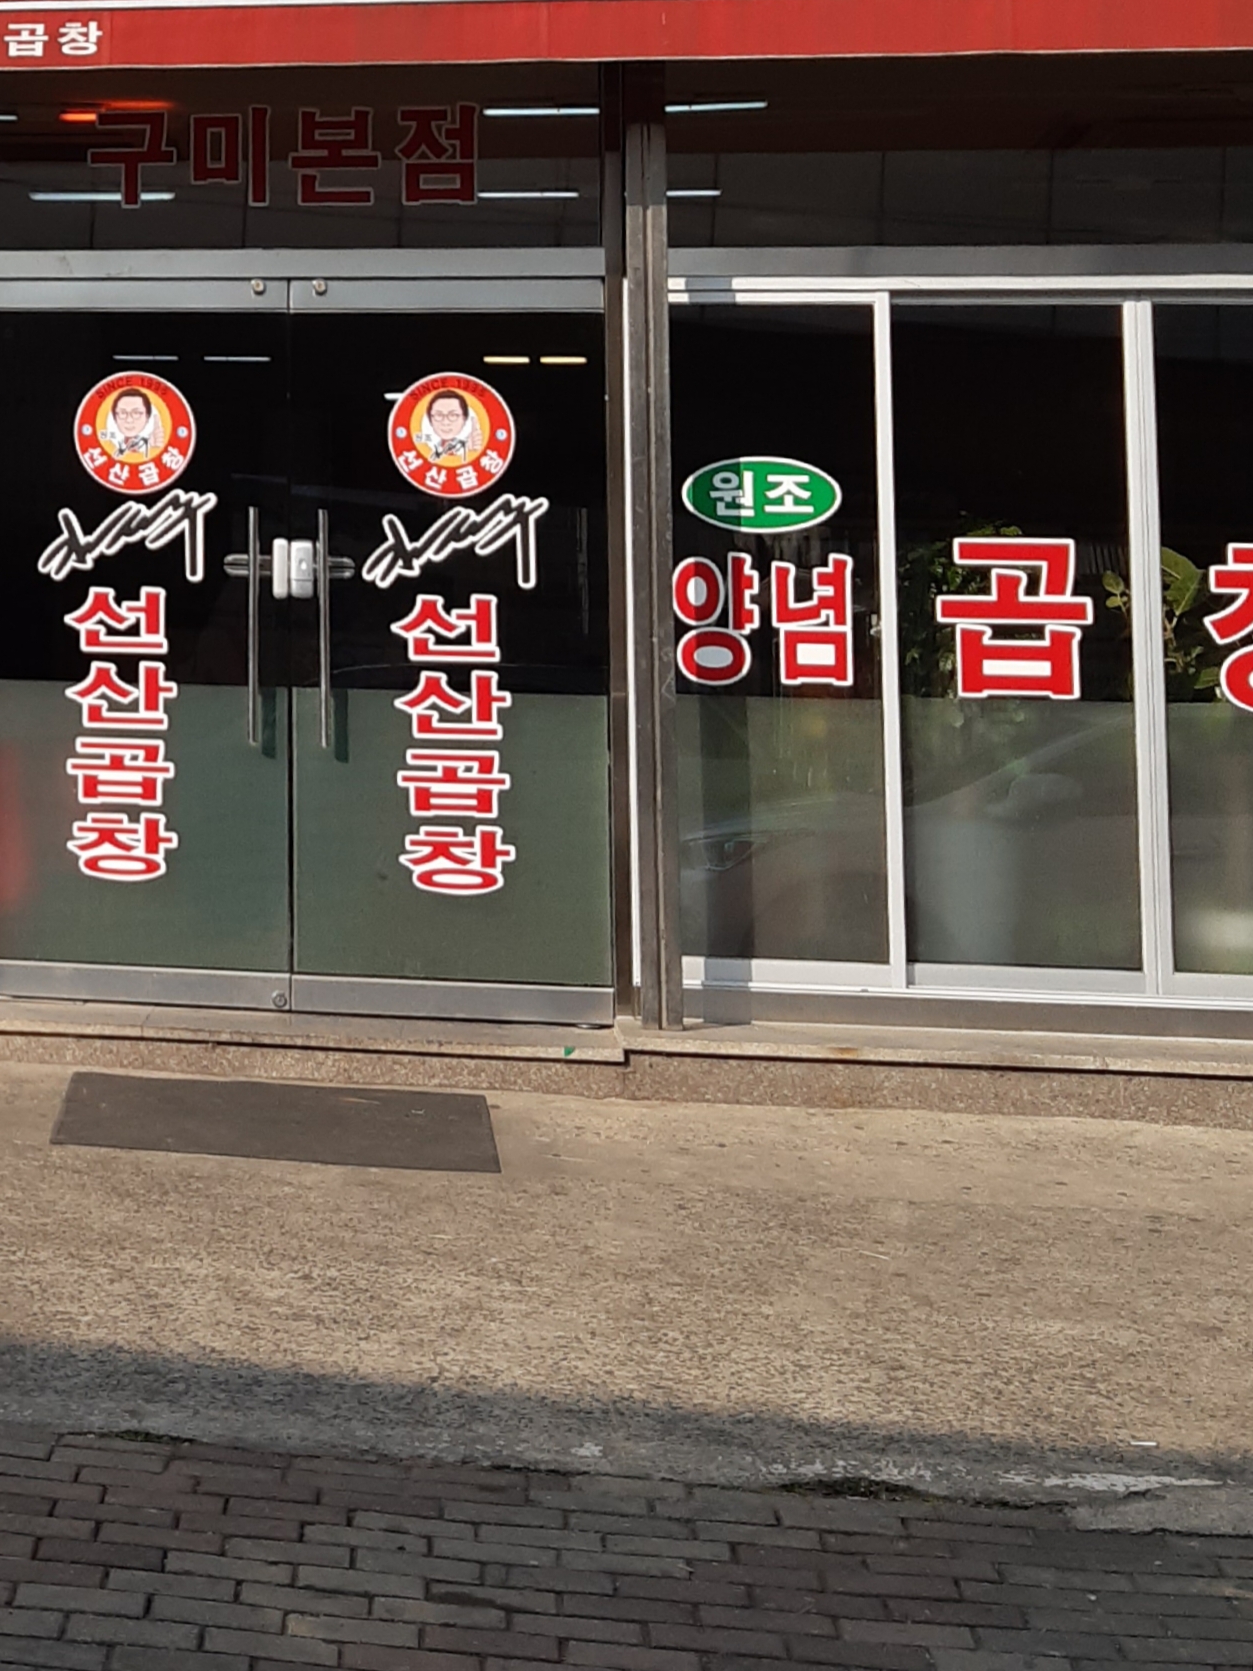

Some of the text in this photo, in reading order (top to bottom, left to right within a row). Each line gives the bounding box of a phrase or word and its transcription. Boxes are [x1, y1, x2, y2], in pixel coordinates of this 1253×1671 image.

[87, 102, 480, 209] 구미본점
[96, 376, 133, 399] SINCE
[410, 378, 447, 400] SINCE
[84, 446, 184, 486] 선산곱창
[398, 449, 503, 490] 선산곱창
[708, 469, 815, 517] 원조
[64, 586, 178, 881] 선산곱창
[390, 593, 515, 896] 선산곱창
